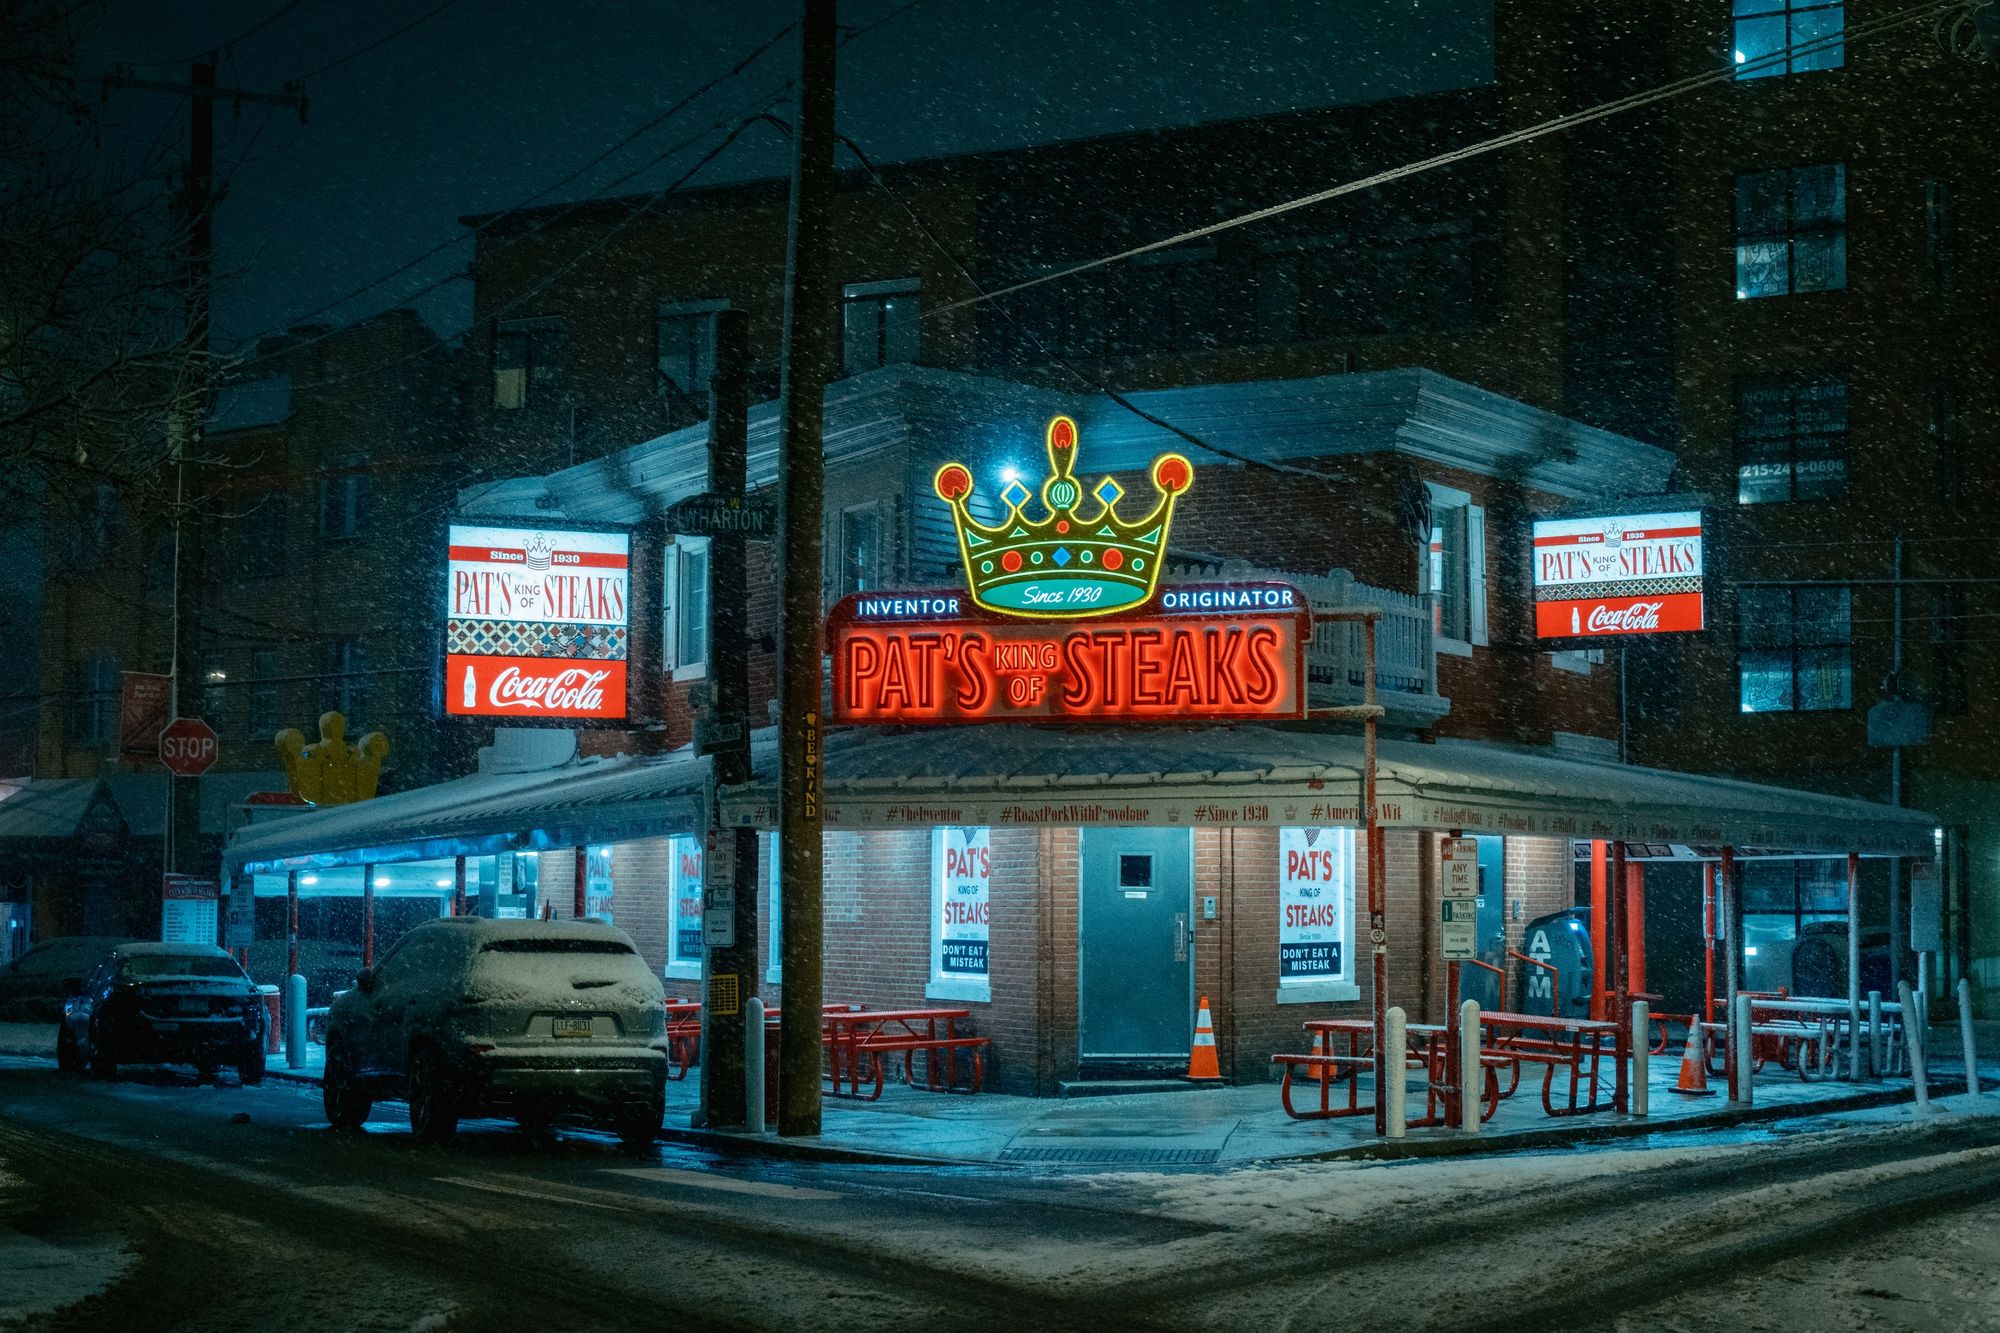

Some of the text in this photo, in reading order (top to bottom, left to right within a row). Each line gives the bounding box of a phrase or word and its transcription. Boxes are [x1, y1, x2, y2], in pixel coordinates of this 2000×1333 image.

[1578, 532, 1645, 543] Since 1930
[490, 550, 580, 564] Since 1930
[1542, 543, 1694, 581] PAT'S STEAKS
[1593, 556, 1617, 564] KING
[455, 571, 624, 621] PAT'S STEAKS
[514, 584, 541, 596] KING
[1021, 585, 1103, 606] Since 1930
[1162, 589, 1294, 608] ORIGINATOR
[520, 597, 535, 609] OF
[858, 598, 959, 616] INVENTOR
[1588, 602, 1663, 632] Coca-Cola
[994, 642, 1057, 671] KING
[848, 627, 1278, 712] PAT'S STEAKS
[489, 666, 611, 709] Coca-Cola
[1008, 675, 1044, 703] OF
[164, 736, 214, 759] STOP
[1194, 803, 1269, 822] #Since 1930
[1453, 845, 1476, 854] PARKING
[947, 848, 990, 879] PAT'S
[1288, 849, 1333, 882] PAT'S
[1452, 864, 1468, 873] ANY
[1452, 874, 1468, 885] TIME
[971, 885, 979, 895] OF
[1299, 888, 1321, 898] KING OF
[944, 901, 990, 925] STEAKS
[1286, 904, 1334, 928] STEAKS
[1452, 912, 1475, 921] PARKING
[943, 945, 966, 956] DON'T
[968, 946, 983, 956] EAT
[1282, 947, 1338, 959] DON'T EAT A
[950, 957, 985, 969] MISTEAK
[1291, 959, 1330, 971] MISTEAK
